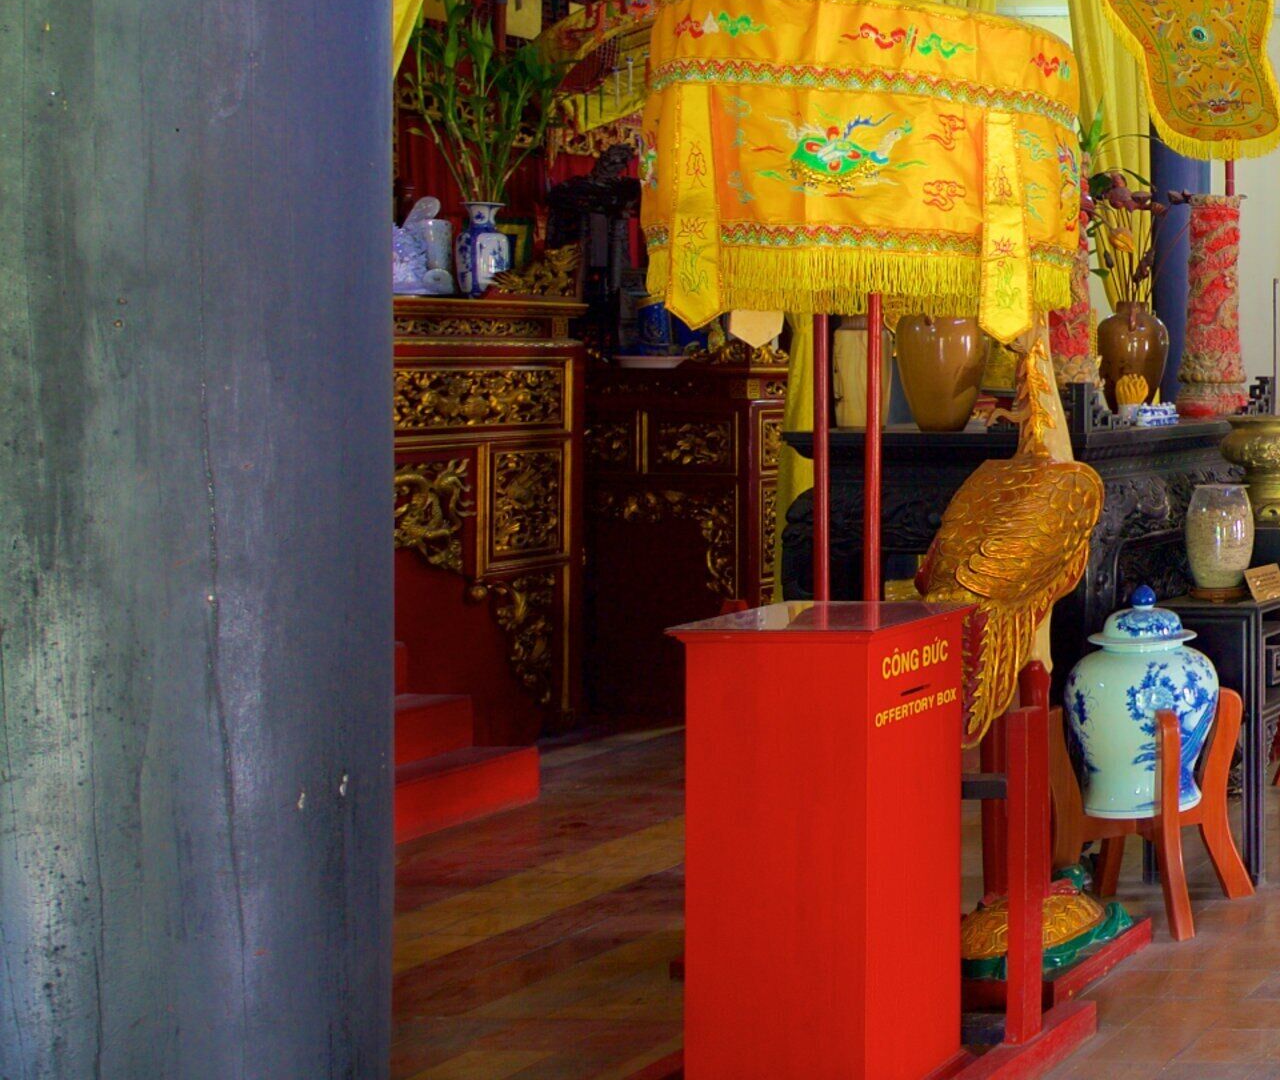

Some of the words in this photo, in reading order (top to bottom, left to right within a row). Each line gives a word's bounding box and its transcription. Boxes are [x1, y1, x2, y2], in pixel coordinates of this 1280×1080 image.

[882, 647, 920, 679] CÔNG
[922, 636, 949, 667] ĐỨC
[875, 694, 936, 728] OFFERTORY
[936, 687, 957, 706] BOX
